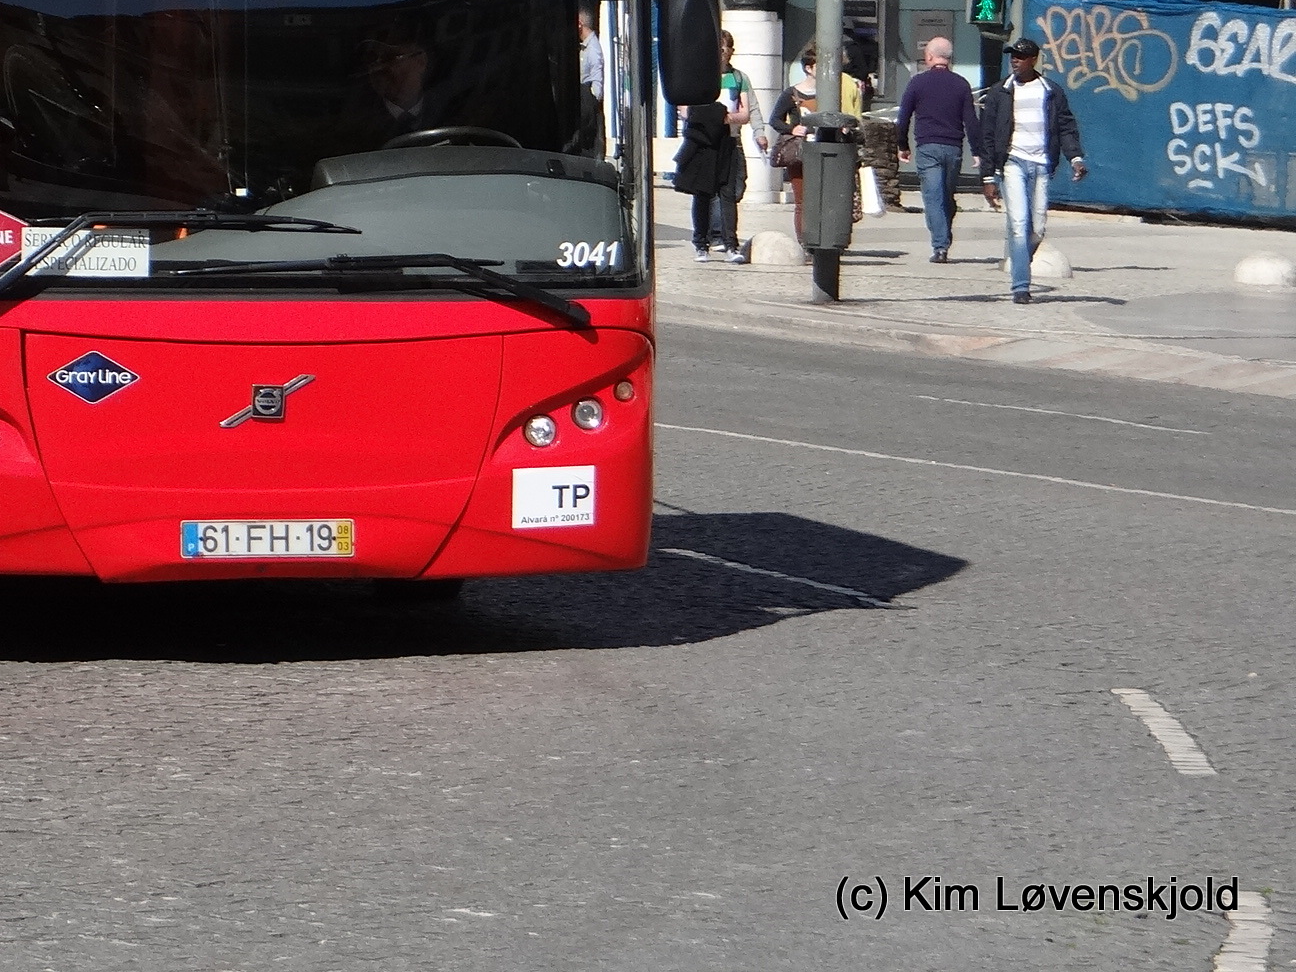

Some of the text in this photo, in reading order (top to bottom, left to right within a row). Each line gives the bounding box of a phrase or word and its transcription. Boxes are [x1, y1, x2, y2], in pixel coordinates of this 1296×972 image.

[1169, 101, 1261, 149] DEFS
[1167, 138, 1267, 187] SCK
[85, 234, 147, 249] REGULAR
[556, 241, 619, 267] 3041
[551, 484, 590, 509] TP
[521, 514, 548, 524] Alvará
[560, 513, 590, 522] 200173
[337, 525, 349, 535] 08
[337, 541, 349, 551] 03
